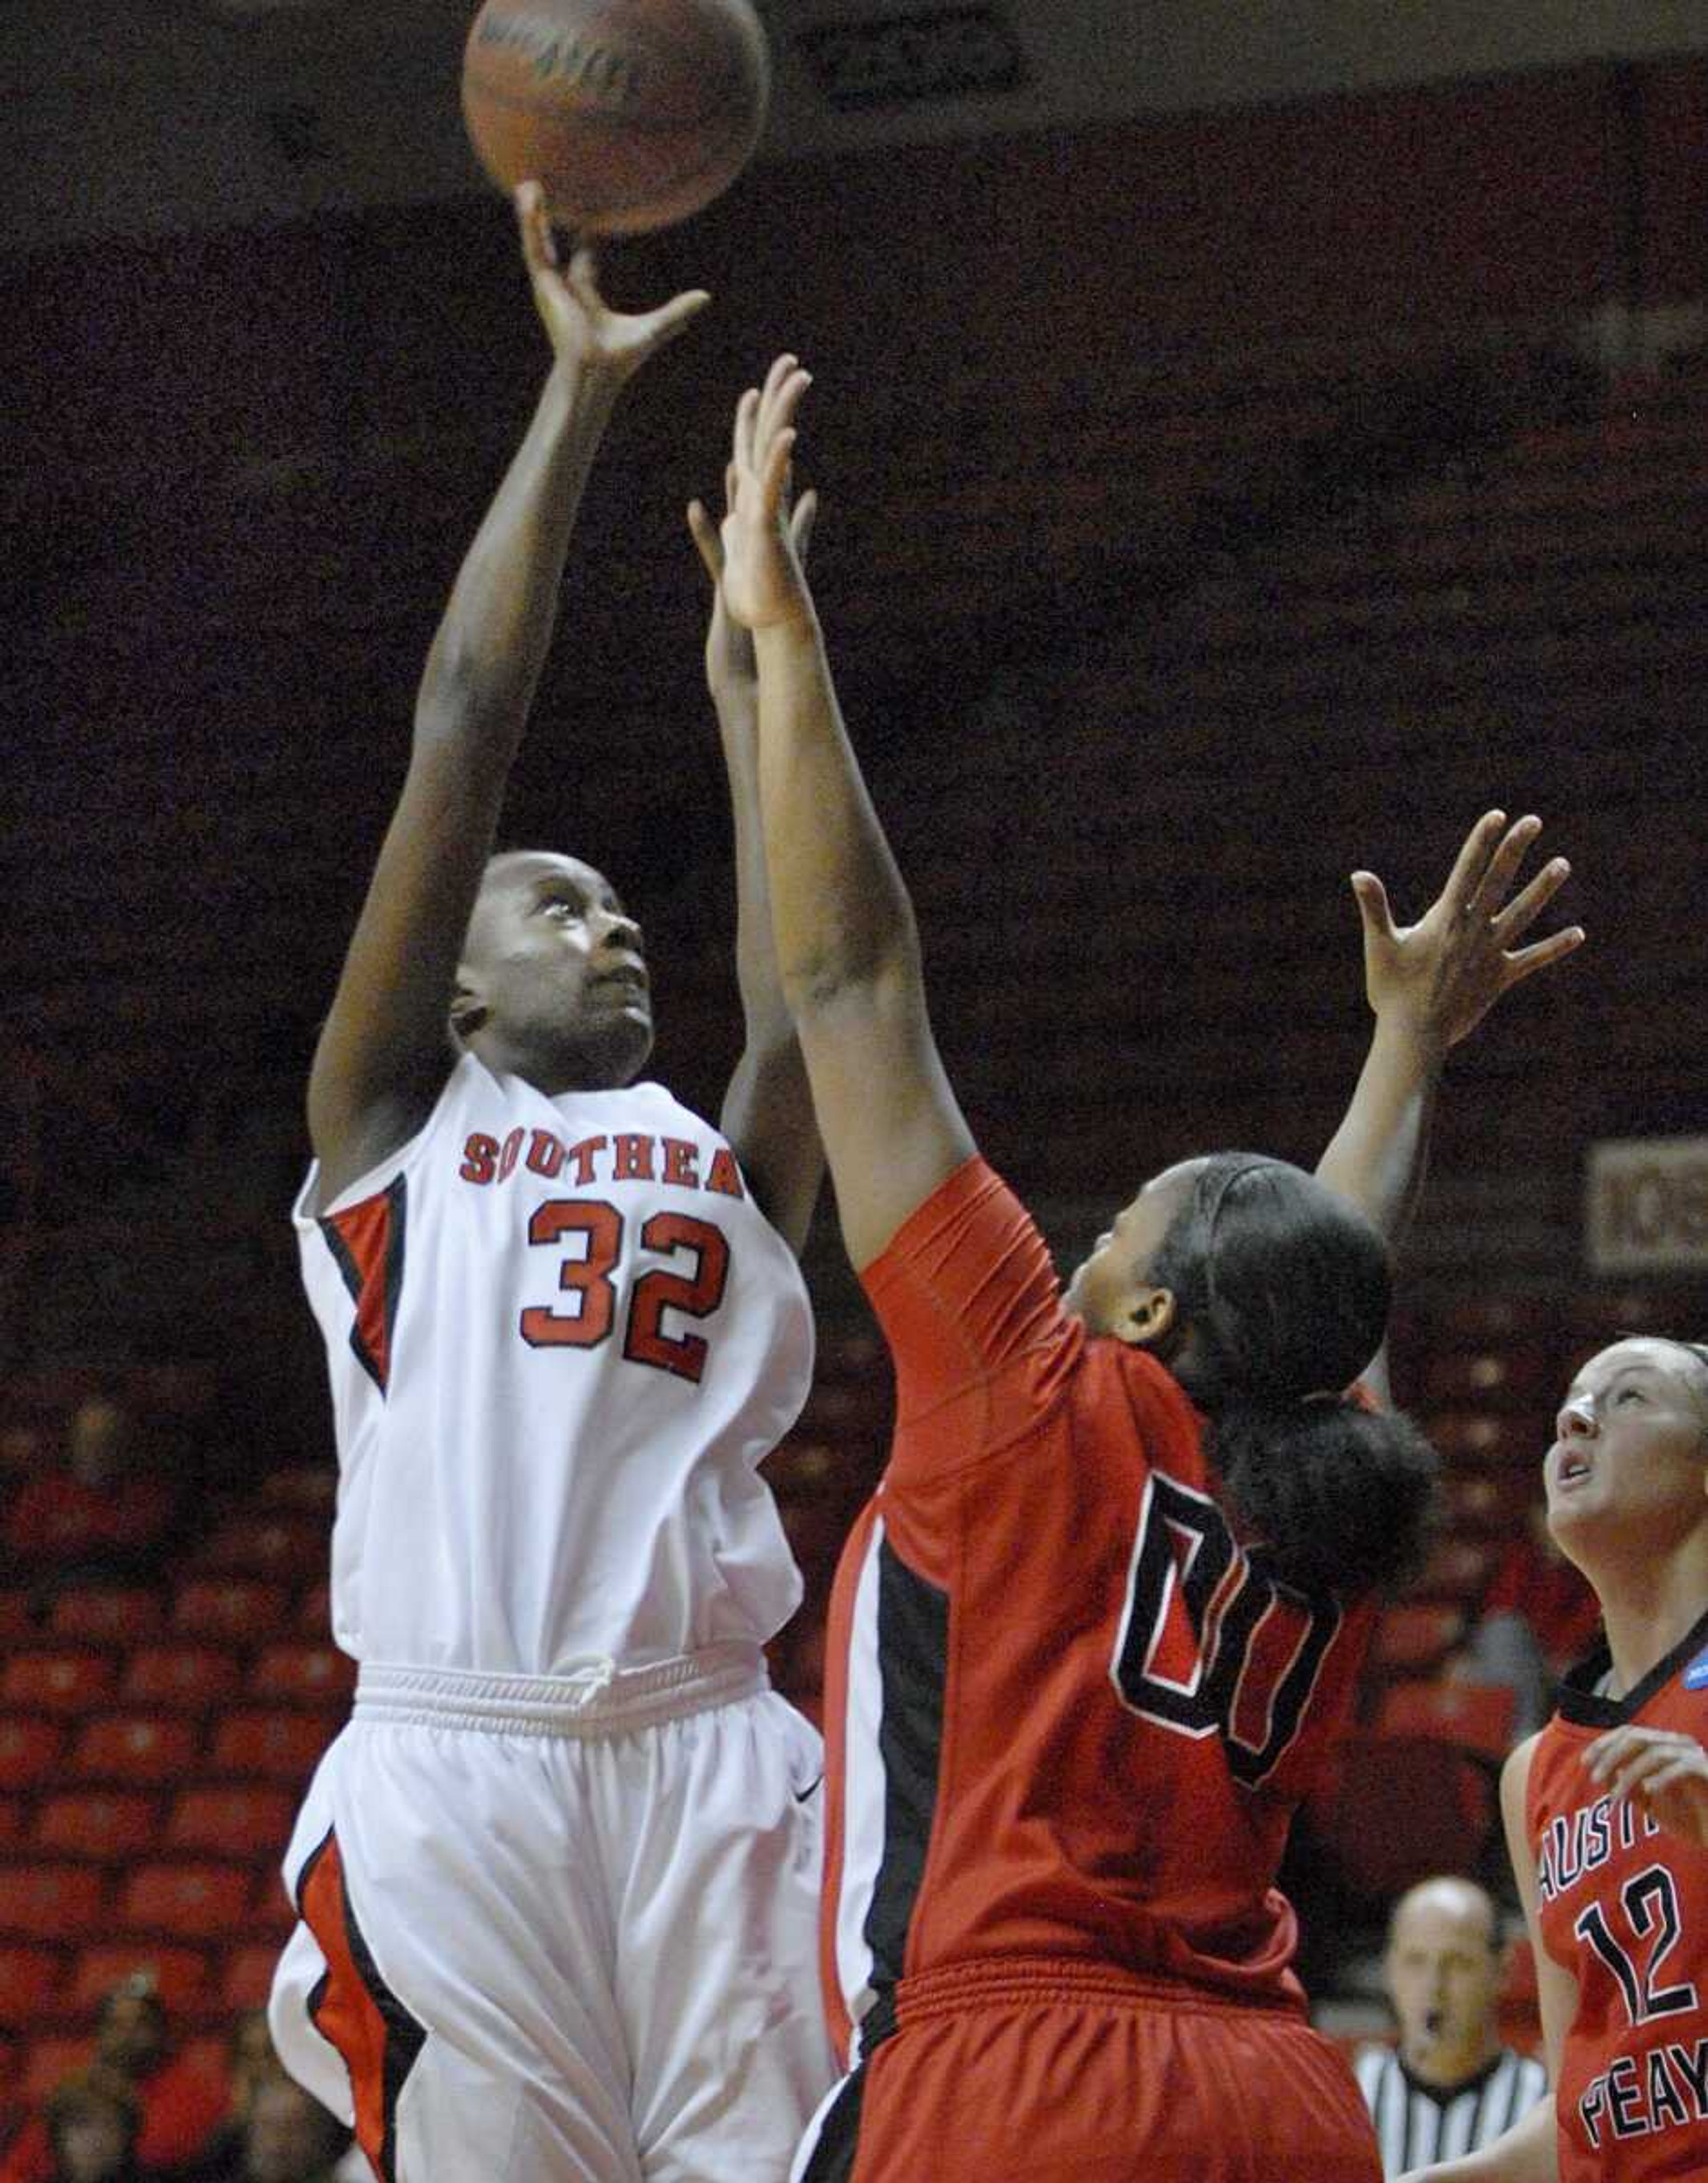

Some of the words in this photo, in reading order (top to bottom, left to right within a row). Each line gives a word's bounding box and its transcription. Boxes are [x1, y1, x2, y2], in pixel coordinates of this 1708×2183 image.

[520, 1198, 730, 1384] 32
[1575, 1863, 1699, 2026] 12
[1579, 2036, 1708, 2149] PEAY
